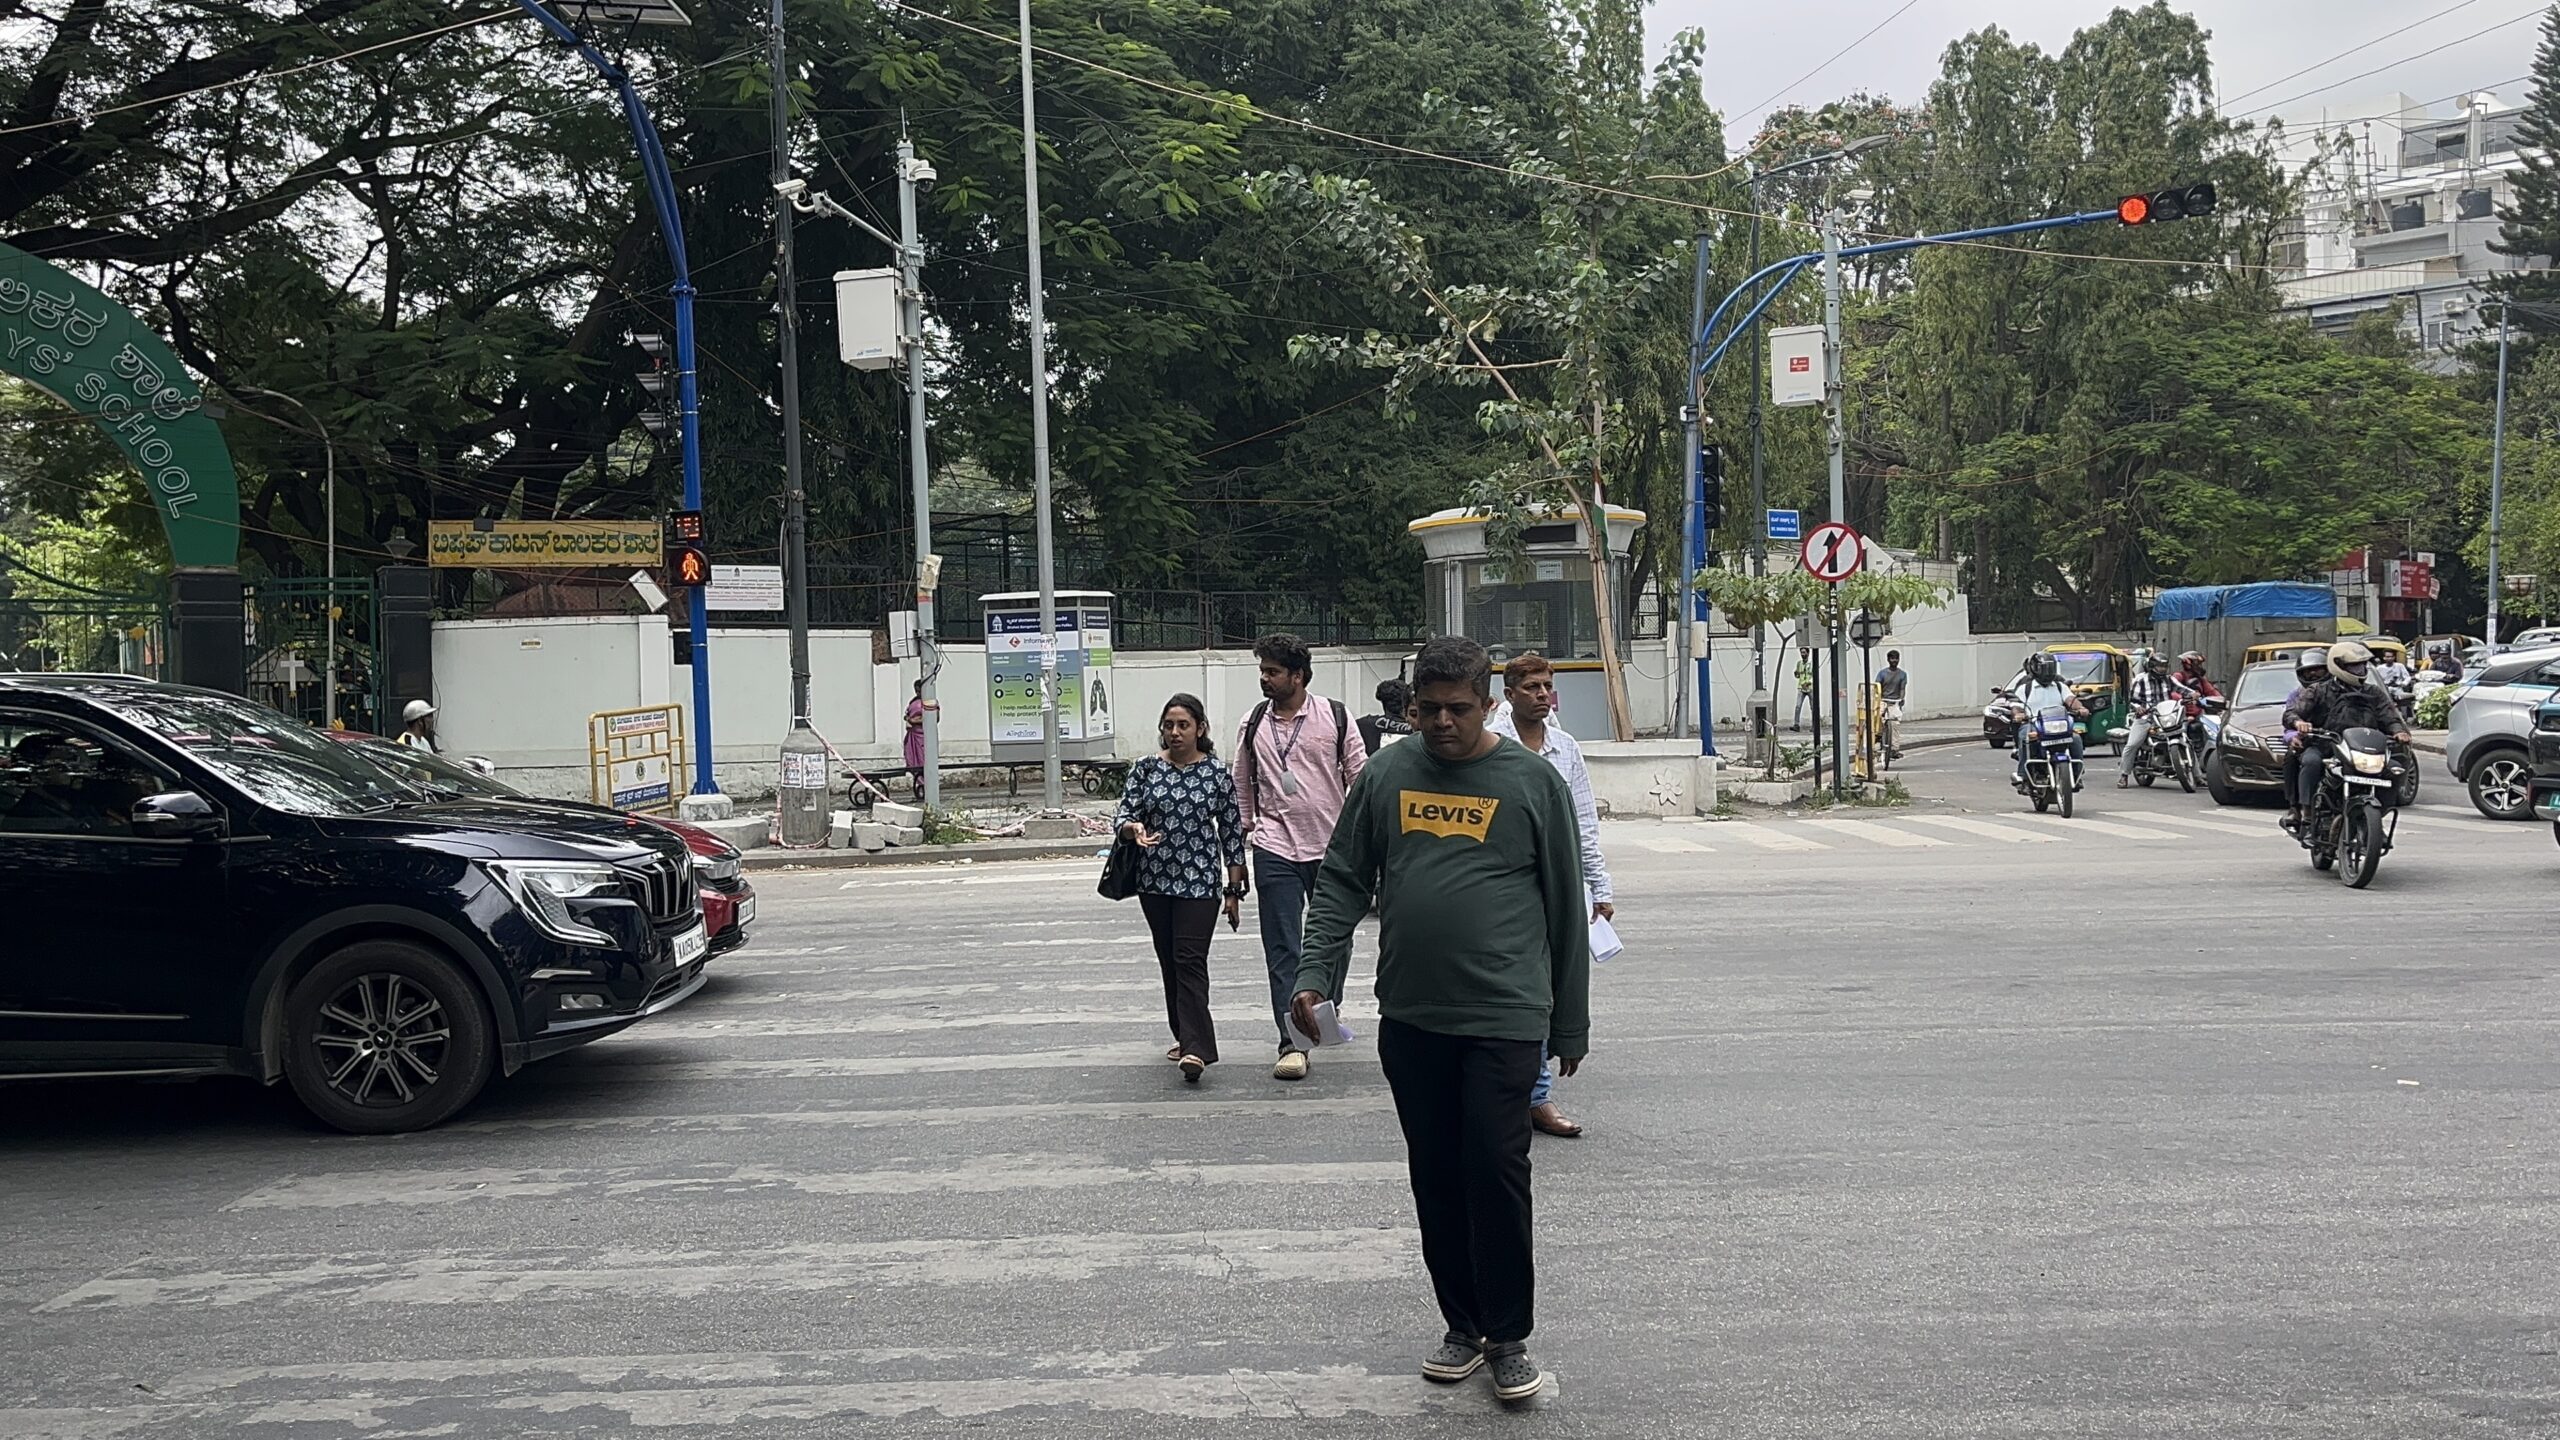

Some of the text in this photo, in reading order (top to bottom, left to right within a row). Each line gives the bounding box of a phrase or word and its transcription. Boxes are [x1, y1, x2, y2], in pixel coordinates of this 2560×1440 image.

[110, 342, 202, 420] ಶಾಲೆ
[75, 373, 198, 519] SCHOOL
[488, 529, 552, 553] ಕಾಟನ್
[552, 531, 621, 554] ಬಾಲಕರ
[623, 528, 660, 554] ಶಾಲೆ
